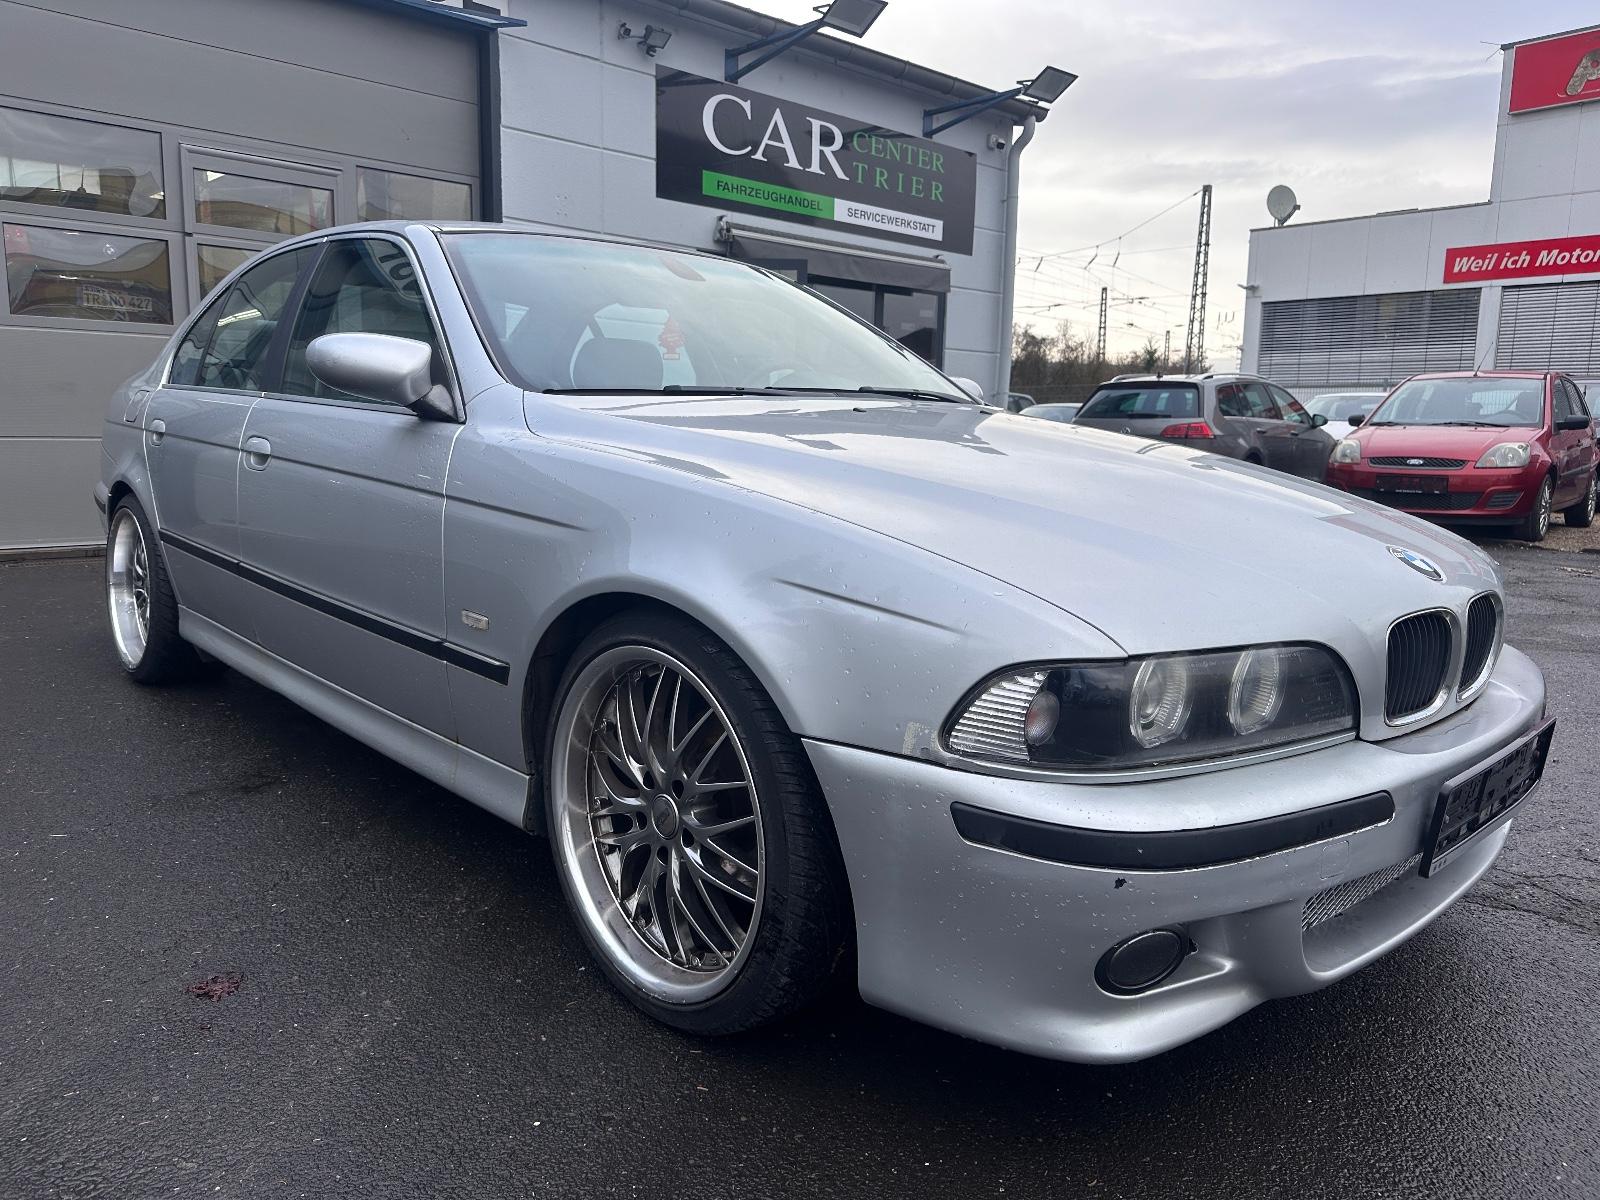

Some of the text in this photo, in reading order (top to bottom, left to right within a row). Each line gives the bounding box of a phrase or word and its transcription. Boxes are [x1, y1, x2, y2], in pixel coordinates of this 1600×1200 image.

[703, 93, 849, 181] CAR
[853, 131, 945, 174] CENTER
[717, 179, 823, 212] FAHRZEUGHANDEL
[853, 161, 944, 202] TRIER
[847, 207, 936, 234] SERVICEWERKSTATT
[1453, 254, 1498, 273] Weil
[1500, 251, 1530, 269] ich
